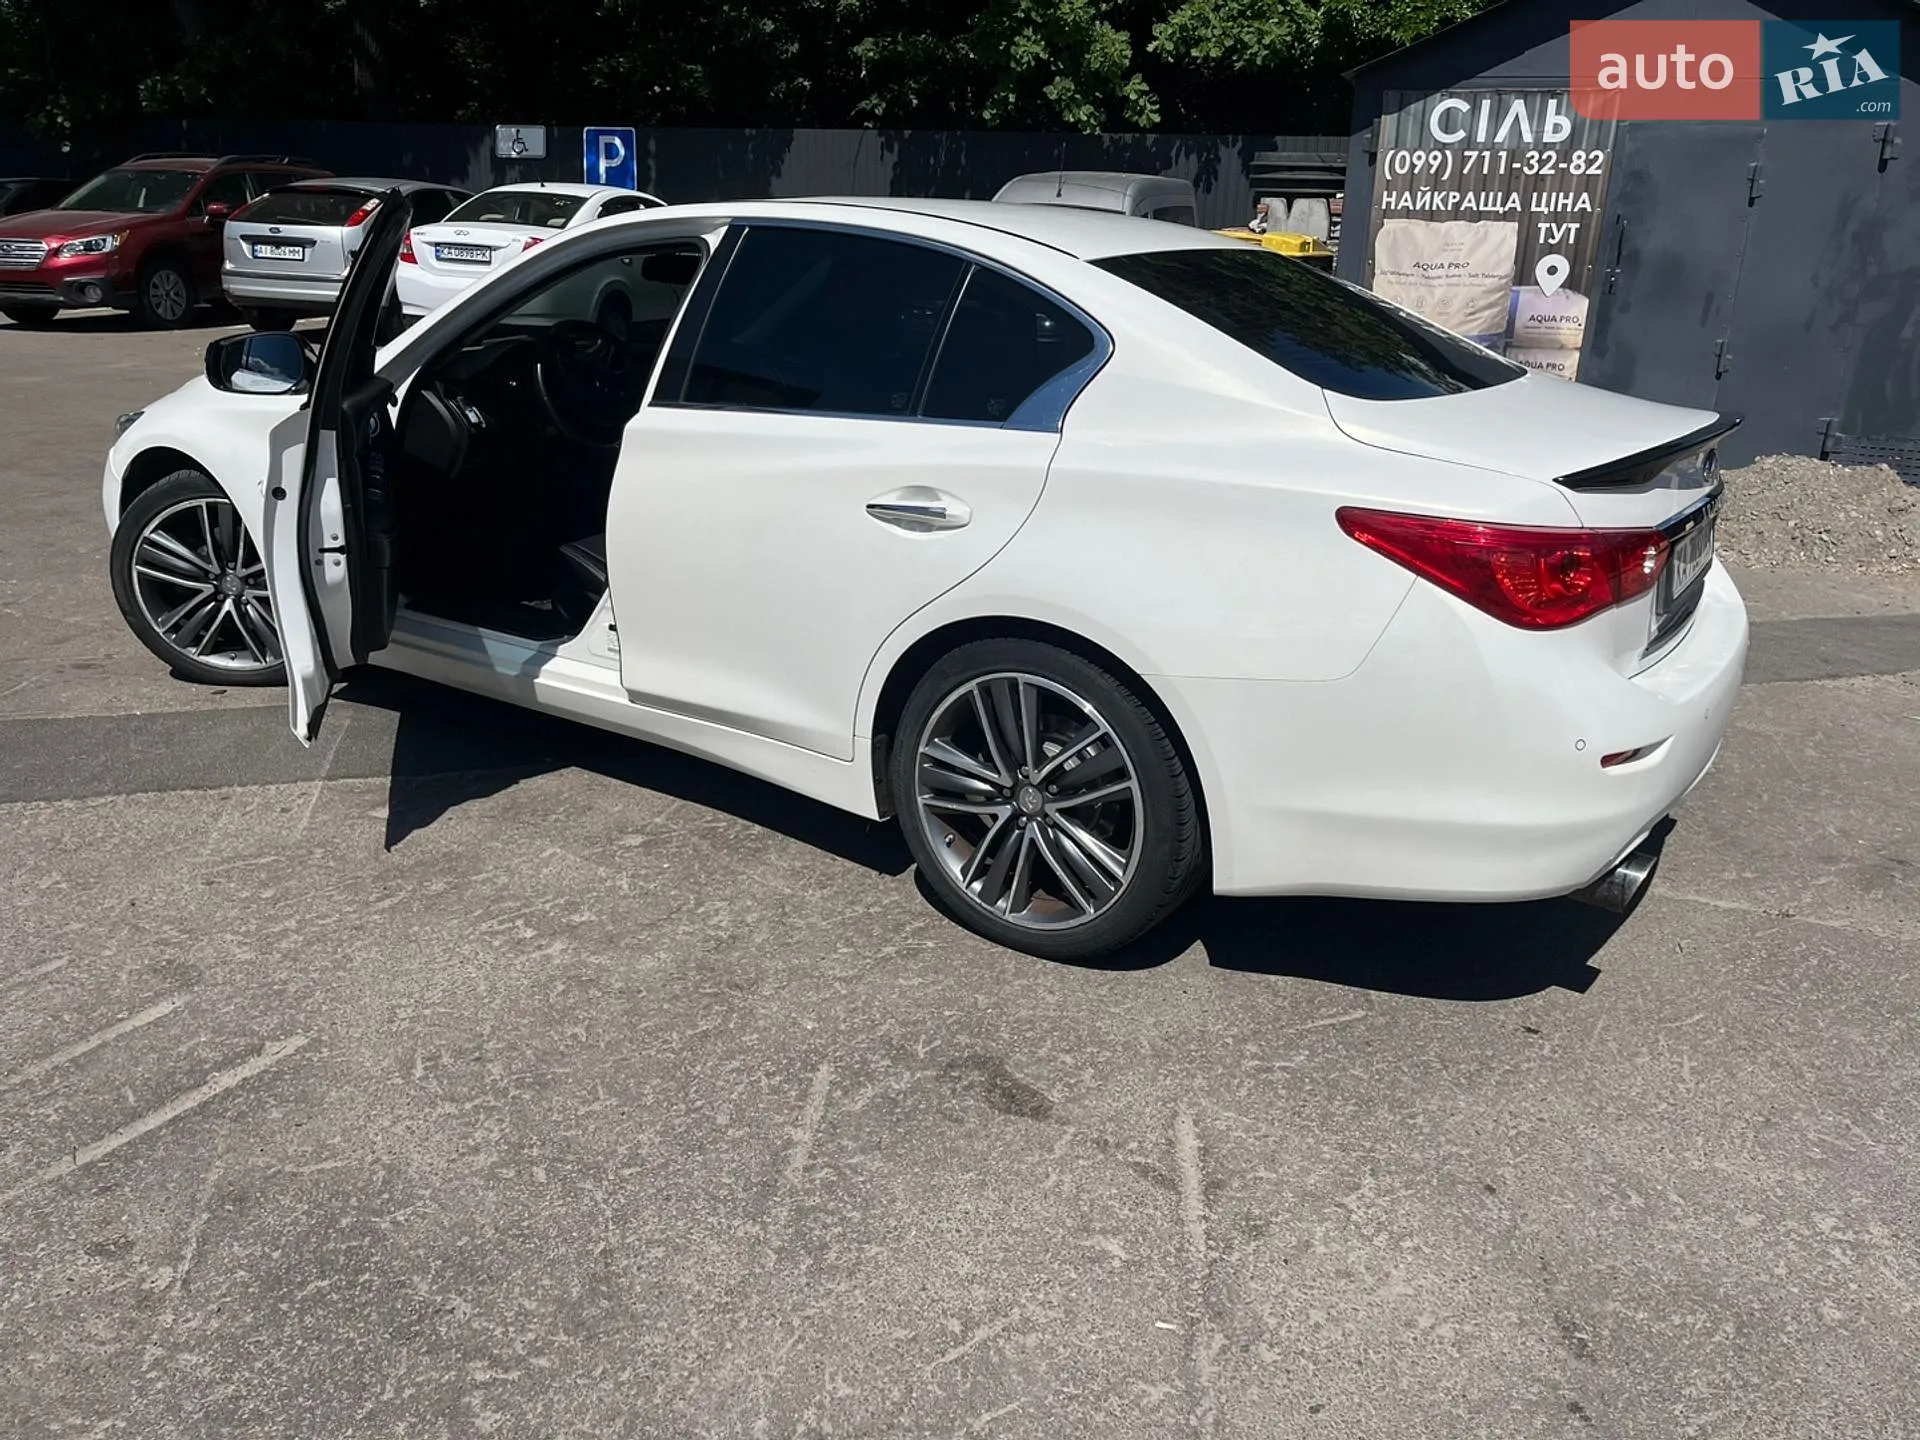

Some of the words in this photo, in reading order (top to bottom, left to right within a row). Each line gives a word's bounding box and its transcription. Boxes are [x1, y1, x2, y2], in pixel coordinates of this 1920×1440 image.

[1429, 98, 1572, 143] СІЛЬ
[599, 135, 625, 184] P
[1383, 150, 1453, 180] (099)
[1462, 150, 1605, 175] 711-32-82
[1381, 186, 1522, 214] НАЙКРАЩА
[1530, 191, 1592, 215] ЦІНА
[1538, 223, 1581, 245] ТУТ
[1412, 262, 1445, 271] AQUA
[1528, 314, 1557, 324] AQUA
[1560, 315, 1579, 324] PRO
[1546, 361, 1565, 371] PRO
